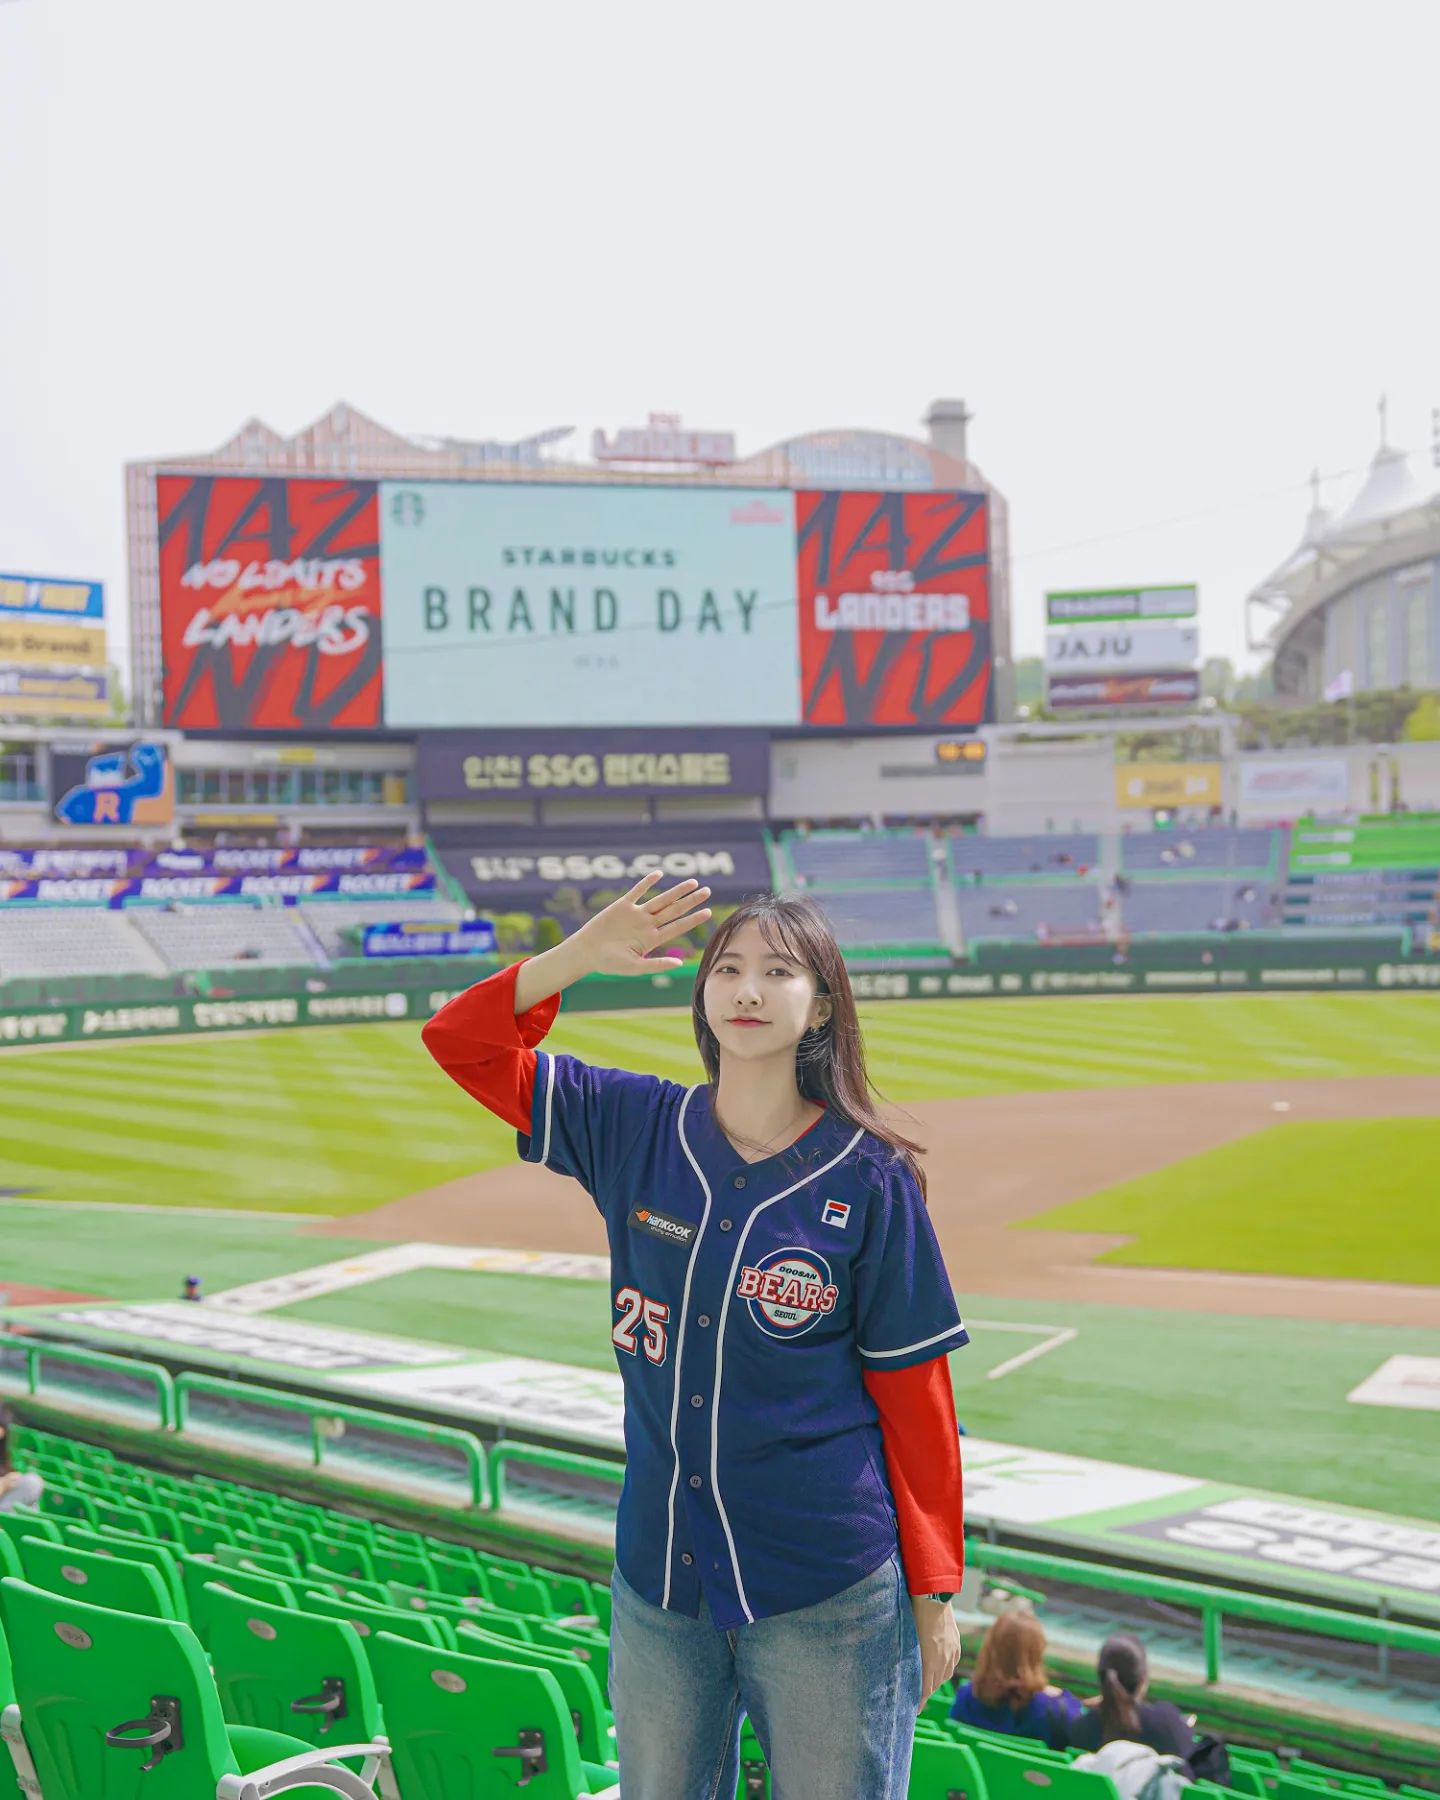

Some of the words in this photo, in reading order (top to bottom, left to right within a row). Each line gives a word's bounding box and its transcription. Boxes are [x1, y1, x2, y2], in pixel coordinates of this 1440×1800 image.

[503, 547, 676, 567] STARBUCKS
[424, 587, 618, 633] BRAND
[656, 588, 757, 634] DAY
[815, 592, 970, 631] LANDERS
[1056, 636, 1133, 660] JAJU
[527, 753, 599, 786] SSG
[537, 851, 734, 880] SSG.COM
[779, 1266, 817, 1280] DOOSAN
[737, 1266, 839, 1315] BEARS
[612, 1285, 670, 1367] 25
[774, 1309, 798, 1321] SEOUL
